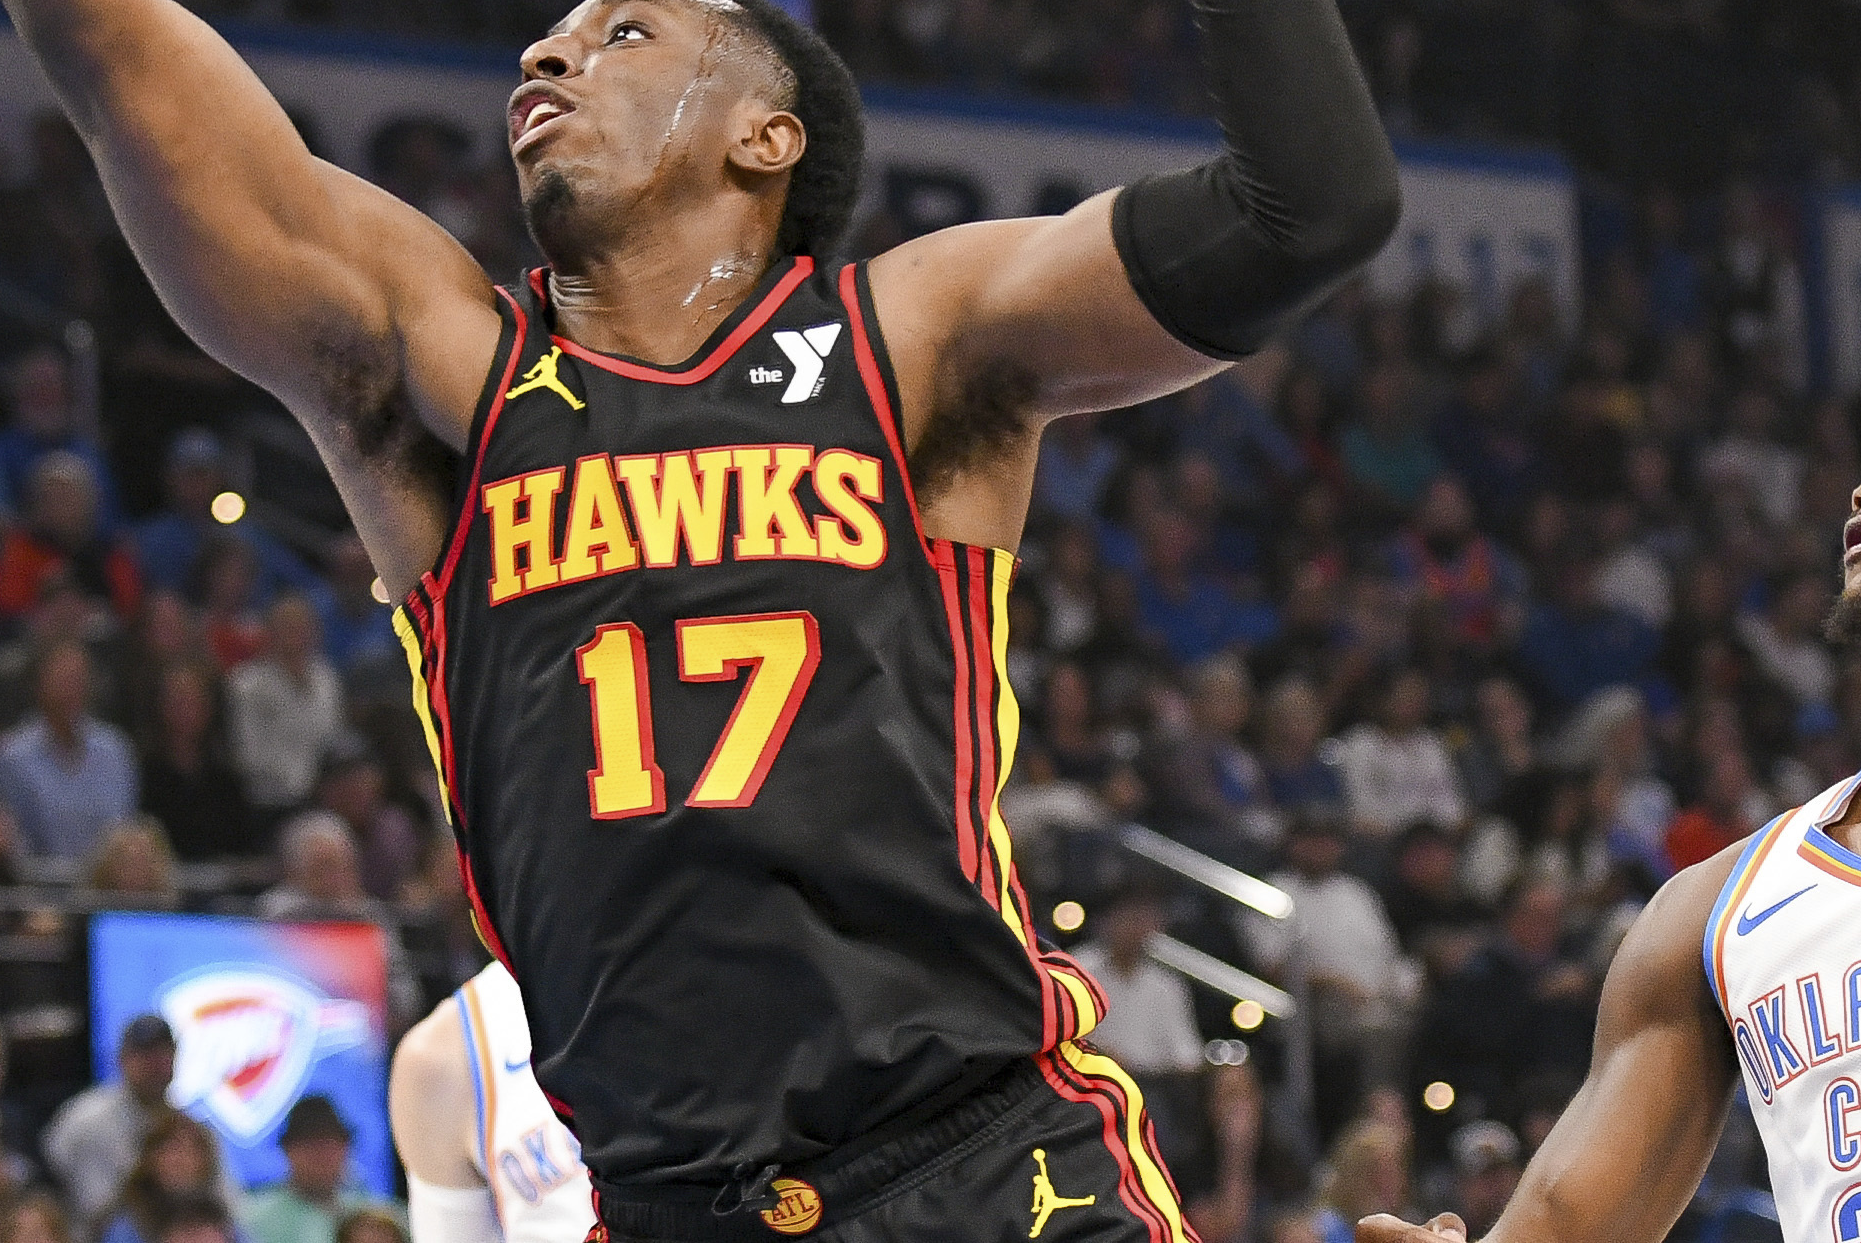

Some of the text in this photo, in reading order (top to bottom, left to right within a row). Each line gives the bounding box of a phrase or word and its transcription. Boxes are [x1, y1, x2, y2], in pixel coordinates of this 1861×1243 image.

[749, 366, 783, 384] the
[481, 443, 889, 607] HAWKS
[575, 610, 823, 820] 17
